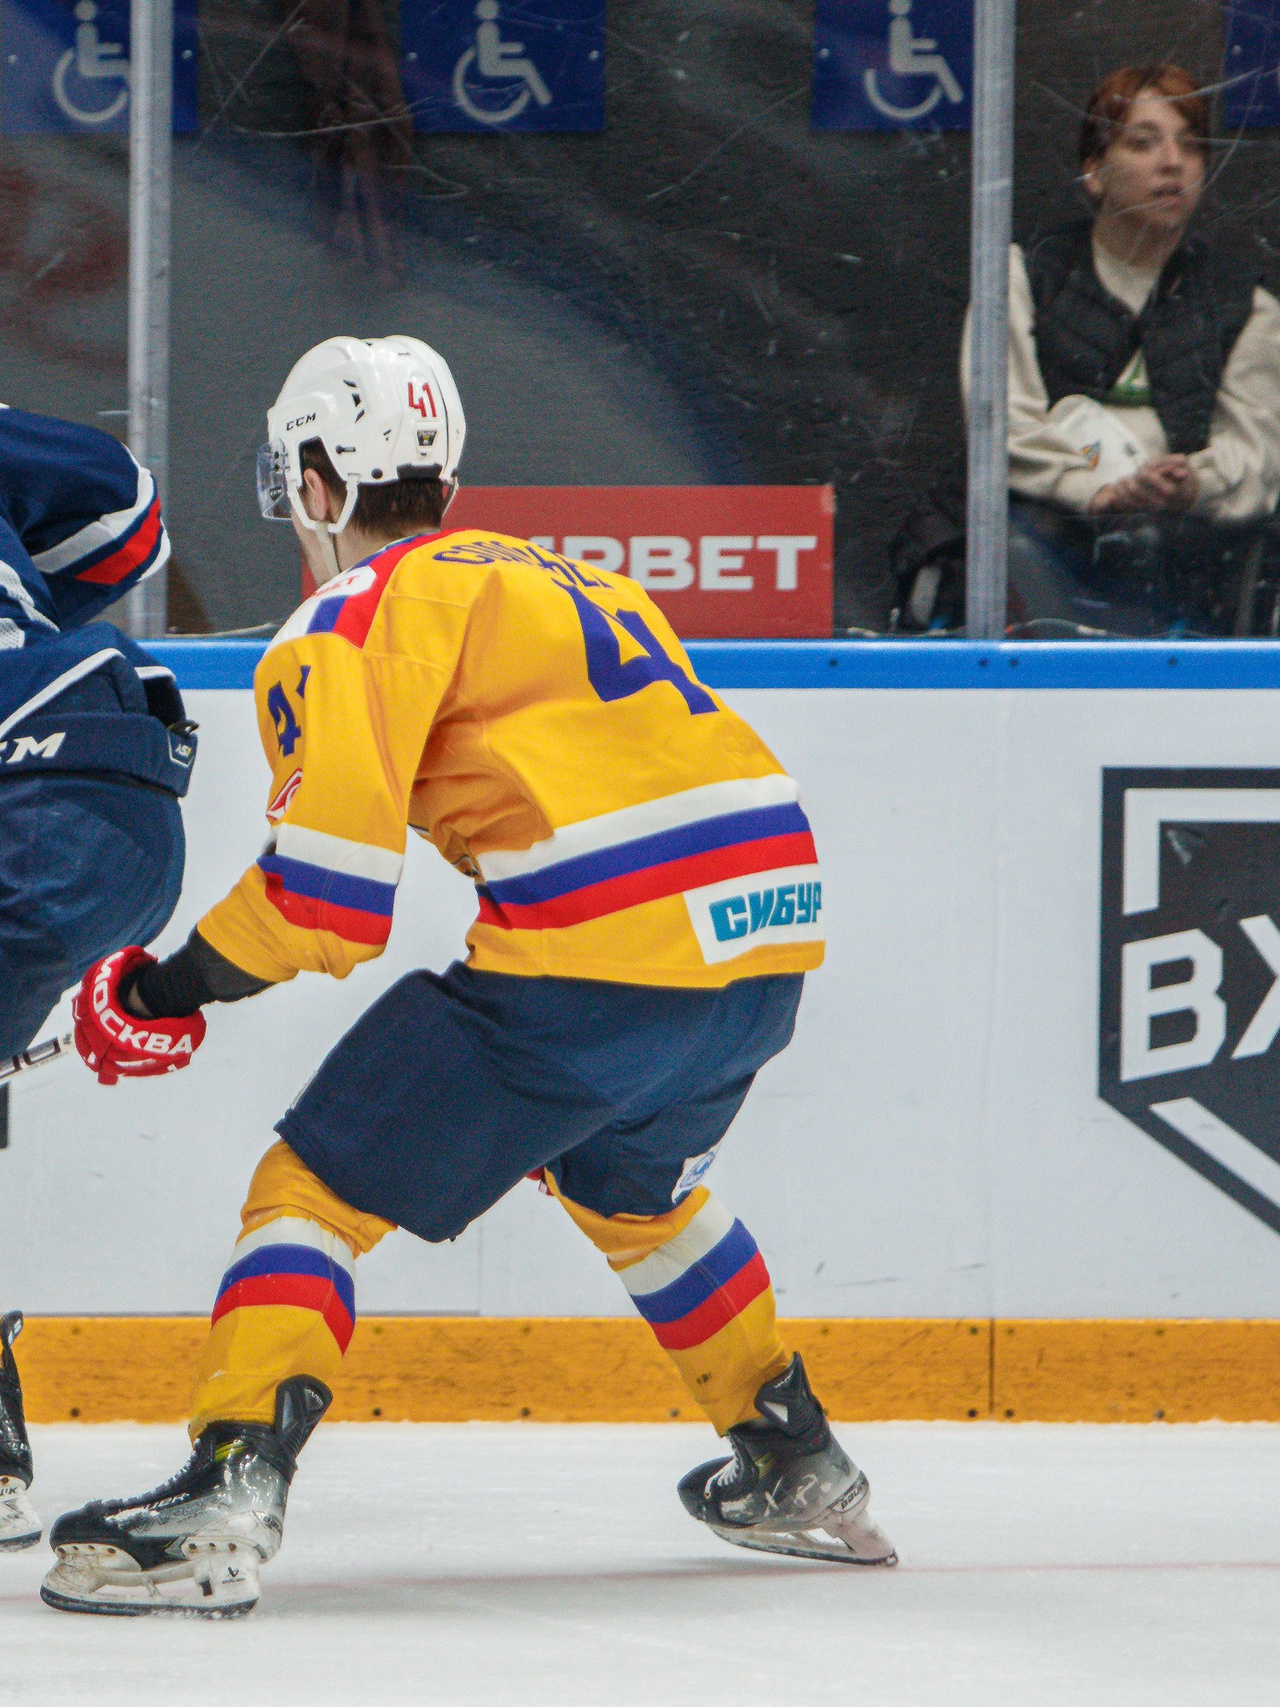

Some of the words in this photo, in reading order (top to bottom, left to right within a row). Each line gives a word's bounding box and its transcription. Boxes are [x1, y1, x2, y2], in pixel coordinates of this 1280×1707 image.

[286, 412, 317, 431] CCM
[408, 382, 437, 418] 41
[527, 535, 818, 591] PBET
[709, 881, 822, 942] СИБУР
[93, 951, 194, 1055] МОСКВА
